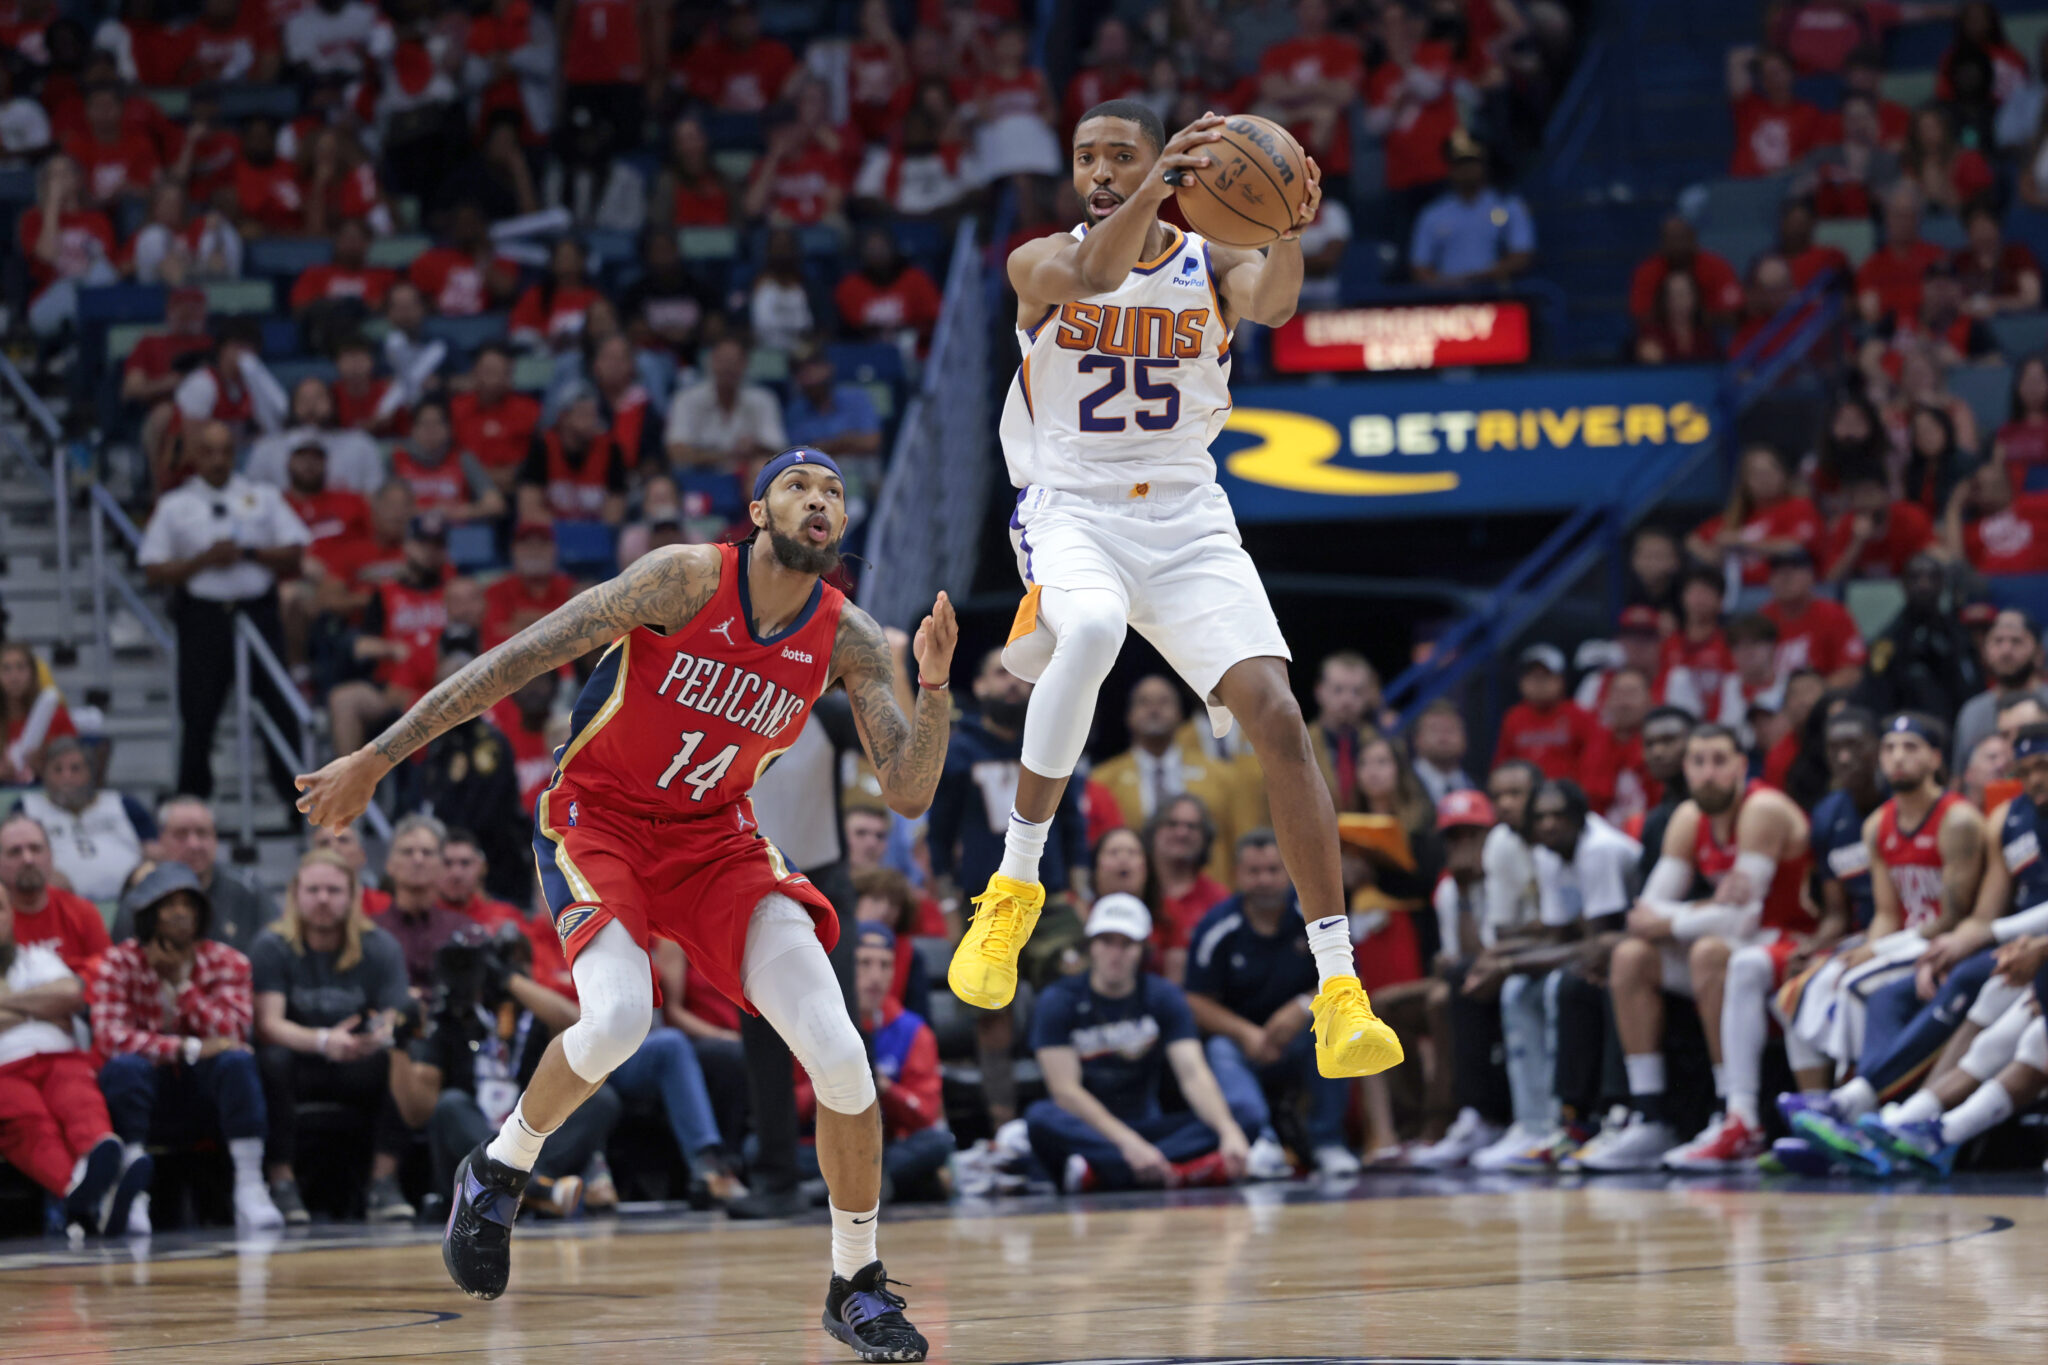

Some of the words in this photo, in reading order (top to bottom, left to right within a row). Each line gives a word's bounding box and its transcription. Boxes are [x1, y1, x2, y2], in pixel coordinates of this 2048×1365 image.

[1226, 117, 1296, 187] Wilson
[1172, 276, 1205, 288] PayPal
[1055, 301, 1210, 359] SUNS
[1078, 354, 1181, 432] 25
[1350, 402, 1710, 457] BETRIVERS
[780, 645, 813, 664] ibotta
[656, 650, 806, 739] PELICANS
[655, 729, 741, 802] 14
